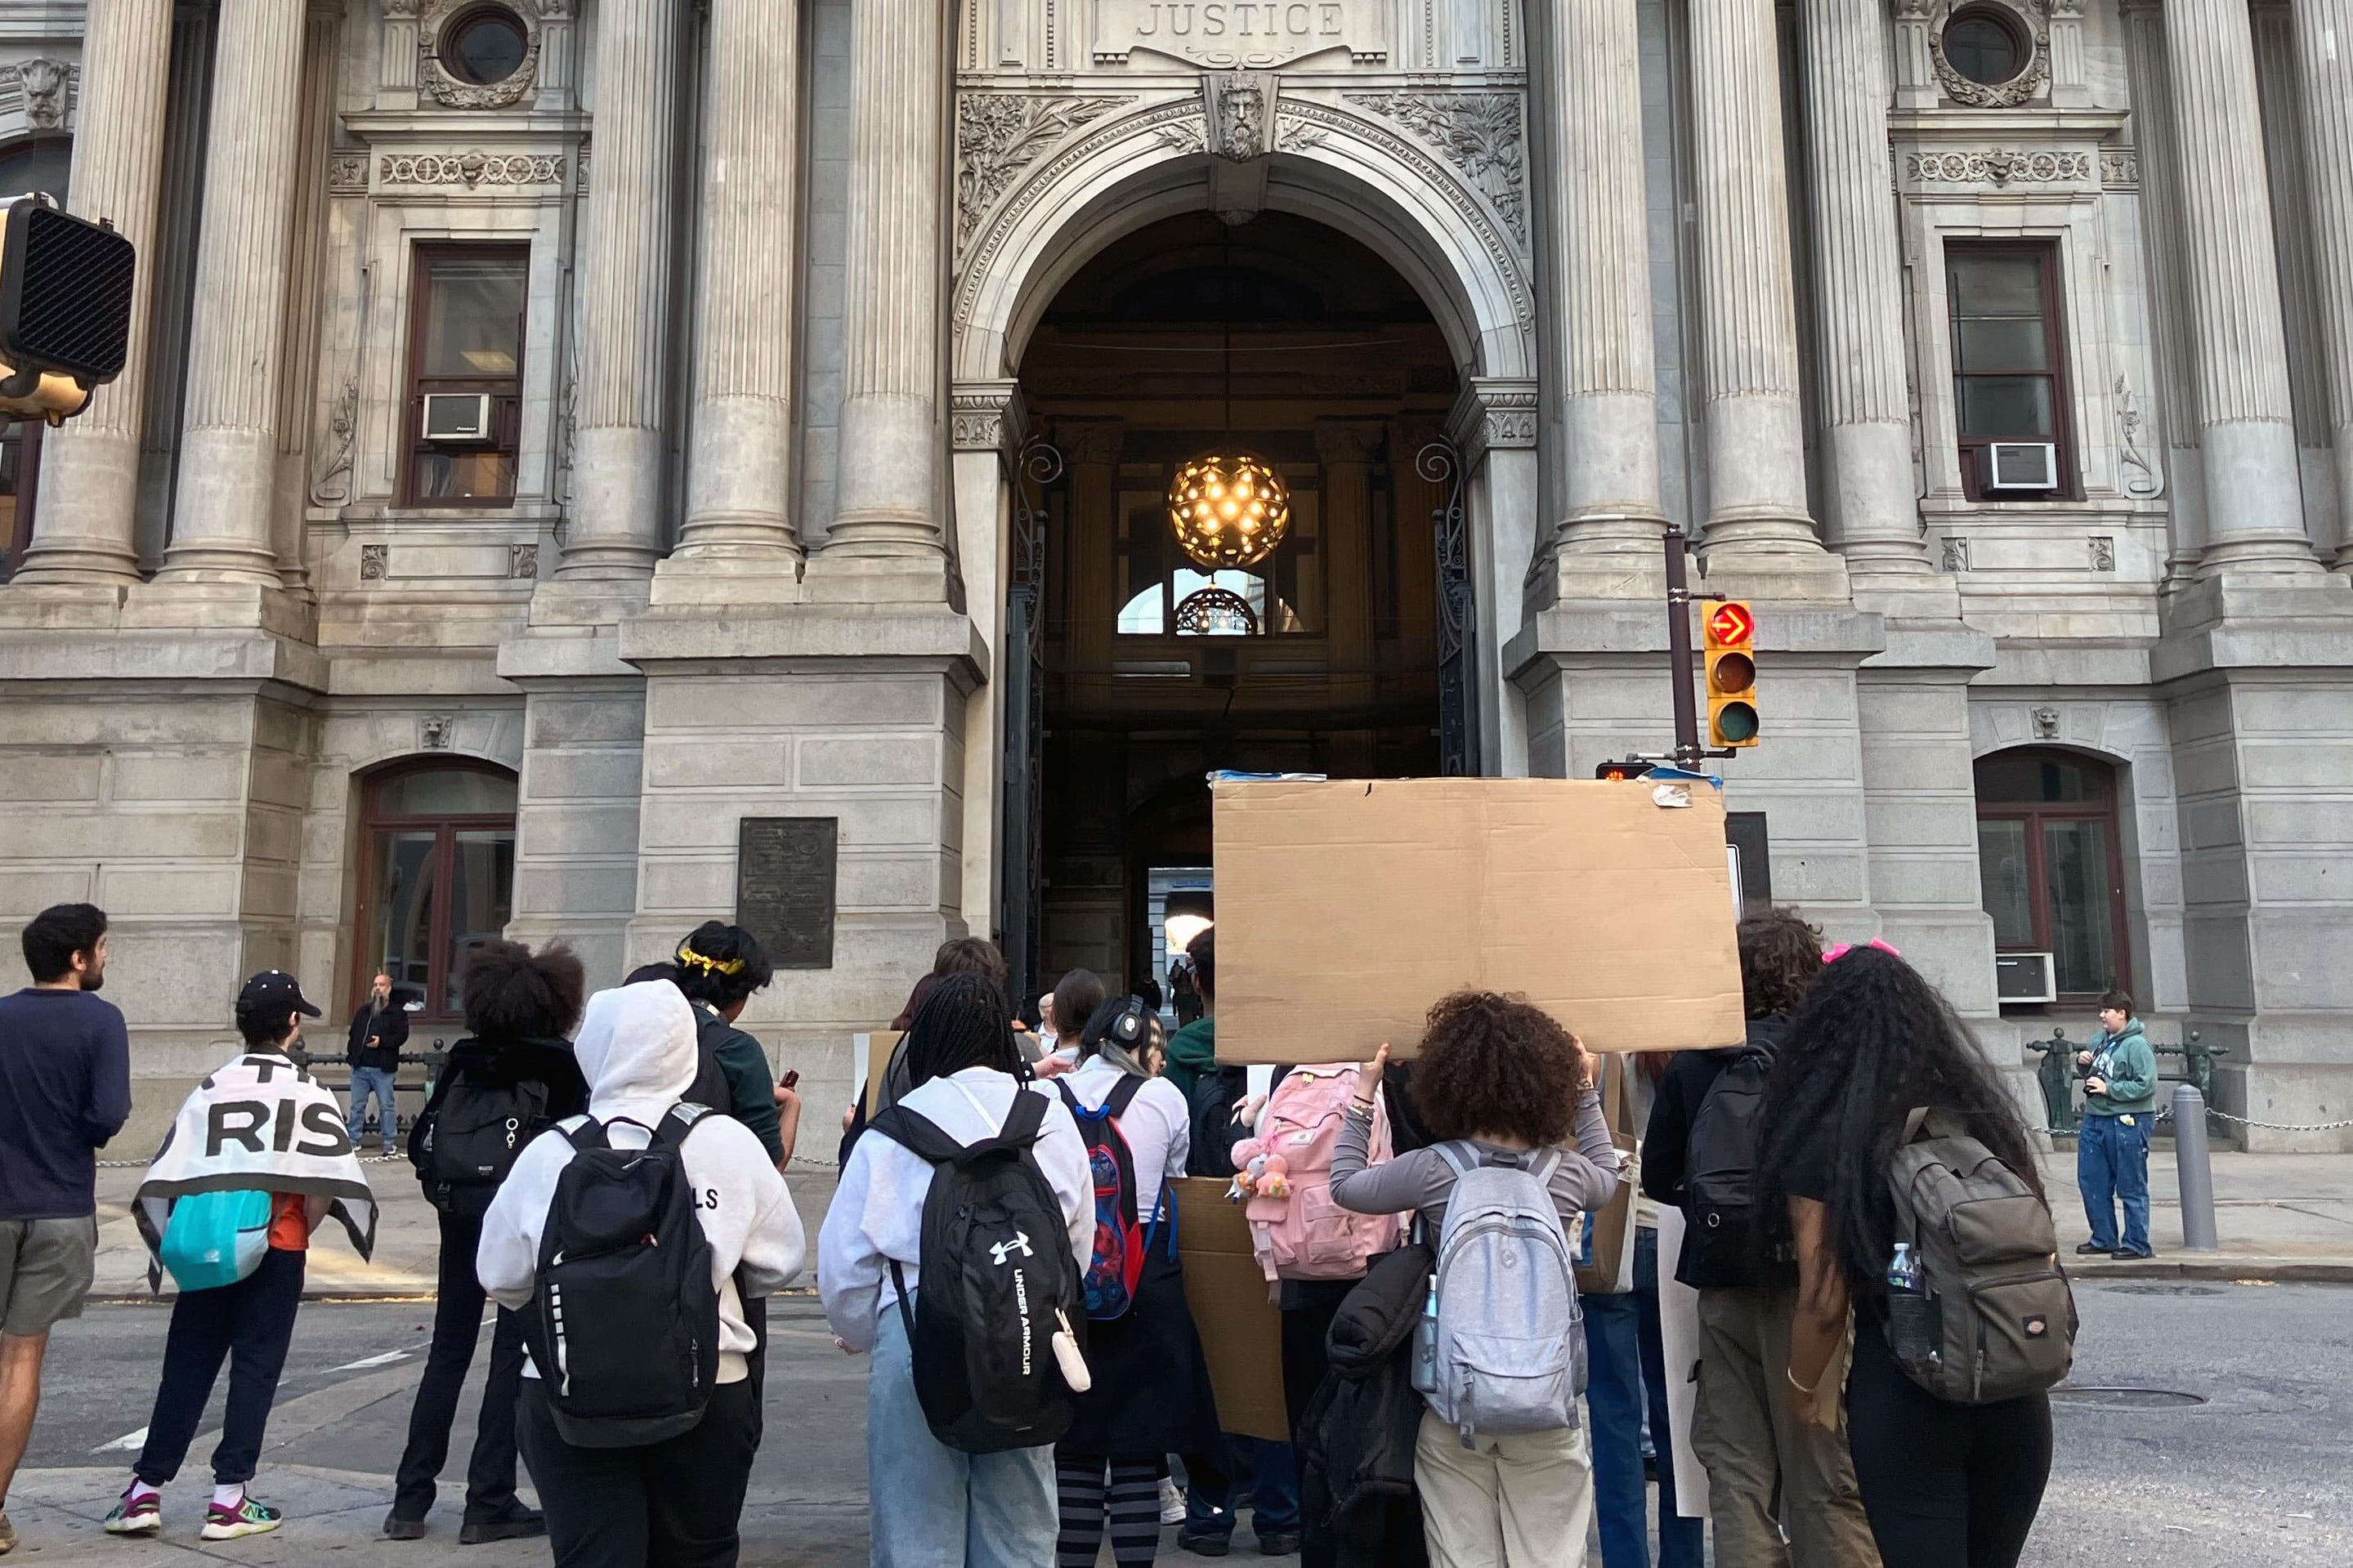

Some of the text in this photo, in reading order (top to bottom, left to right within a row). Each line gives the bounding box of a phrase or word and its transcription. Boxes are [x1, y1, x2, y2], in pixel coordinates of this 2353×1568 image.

[1136, 3, 1342, 36] JUSTICE
[1013, 1269, 1031, 1375] UNDER ARMOUR
